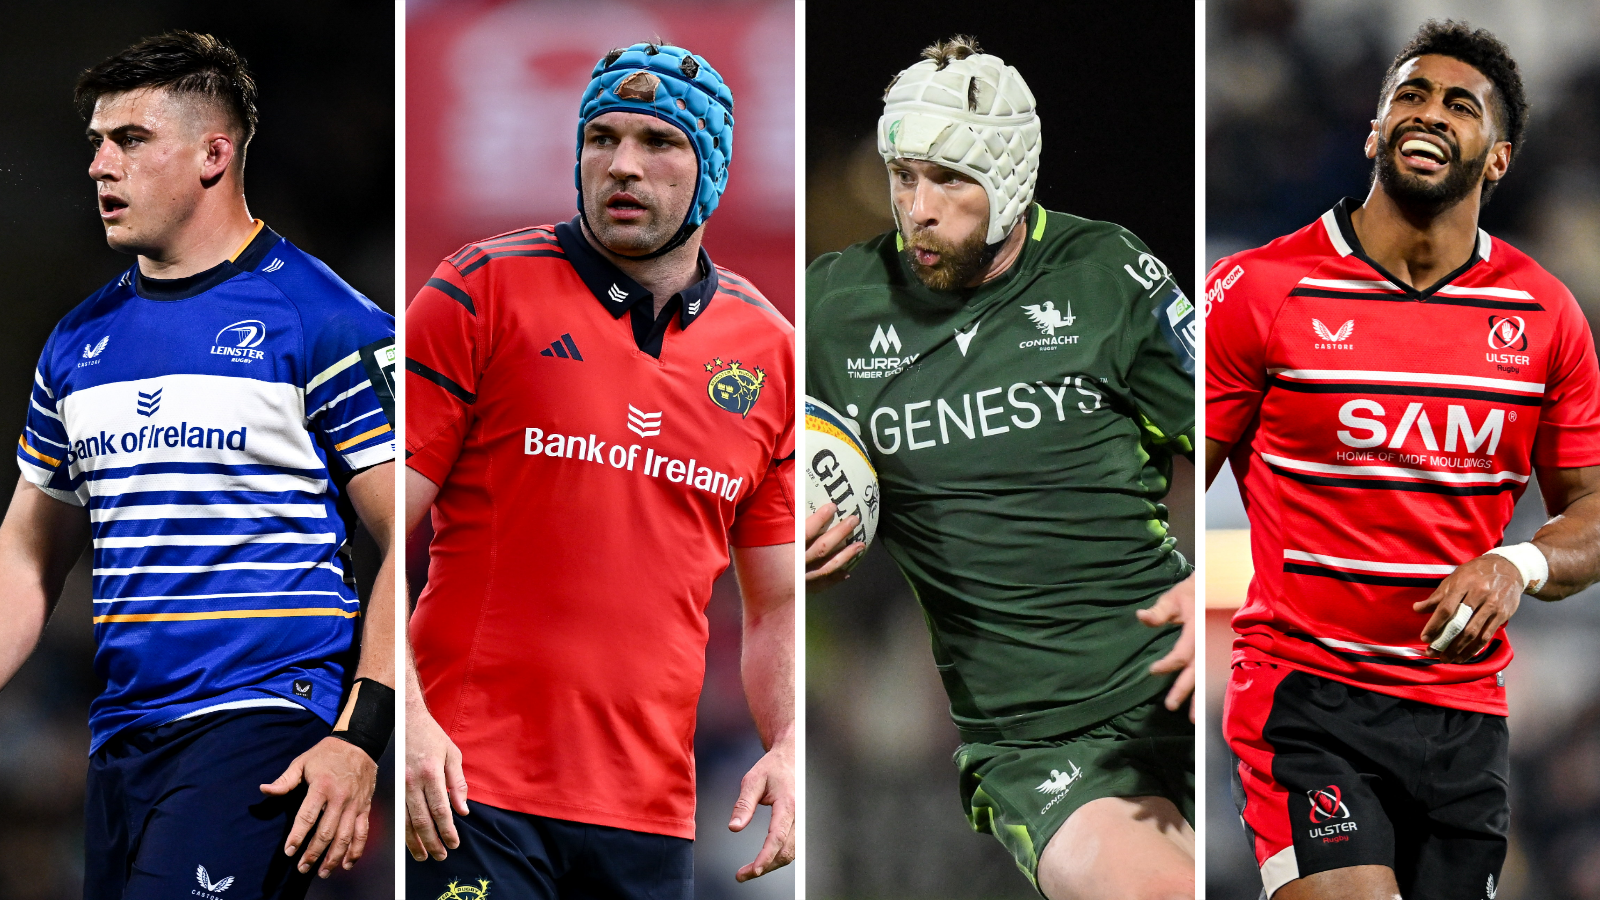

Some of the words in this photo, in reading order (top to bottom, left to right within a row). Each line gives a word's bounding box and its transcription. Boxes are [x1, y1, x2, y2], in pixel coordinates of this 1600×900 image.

[1019, 335, 1080, 349] CONNACHT
[210, 345, 265, 360] LEINSTER
[1486, 352, 1530, 366] ULSTER
[847, 353, 920, 370] MURRAY
[1497, 364, 1520, 374] Rugby
[847, 371, 883, 379] TIMBER
[870, 376, 1102, 455] GENESYS
[1336, 398, 1505, 456] SAM
[121, 425, 148, 454] of
[148, 421, 247, 452] Ireland
[524, 427, 606, 465] Bank
[608, 444, 641, 471] of
[643, 447, 743, 502] Ireland
[1336, 451, 1375, 461] HOME
[1378, 451, 1395, 462] OF
[1400, 453, 1427, 466] MDF
[1429, 455, 1493, 469] MOULDINGS
[1309, 821, 1358, 839] ULSTER
[1322, 834, 1349, 844] Rugby
